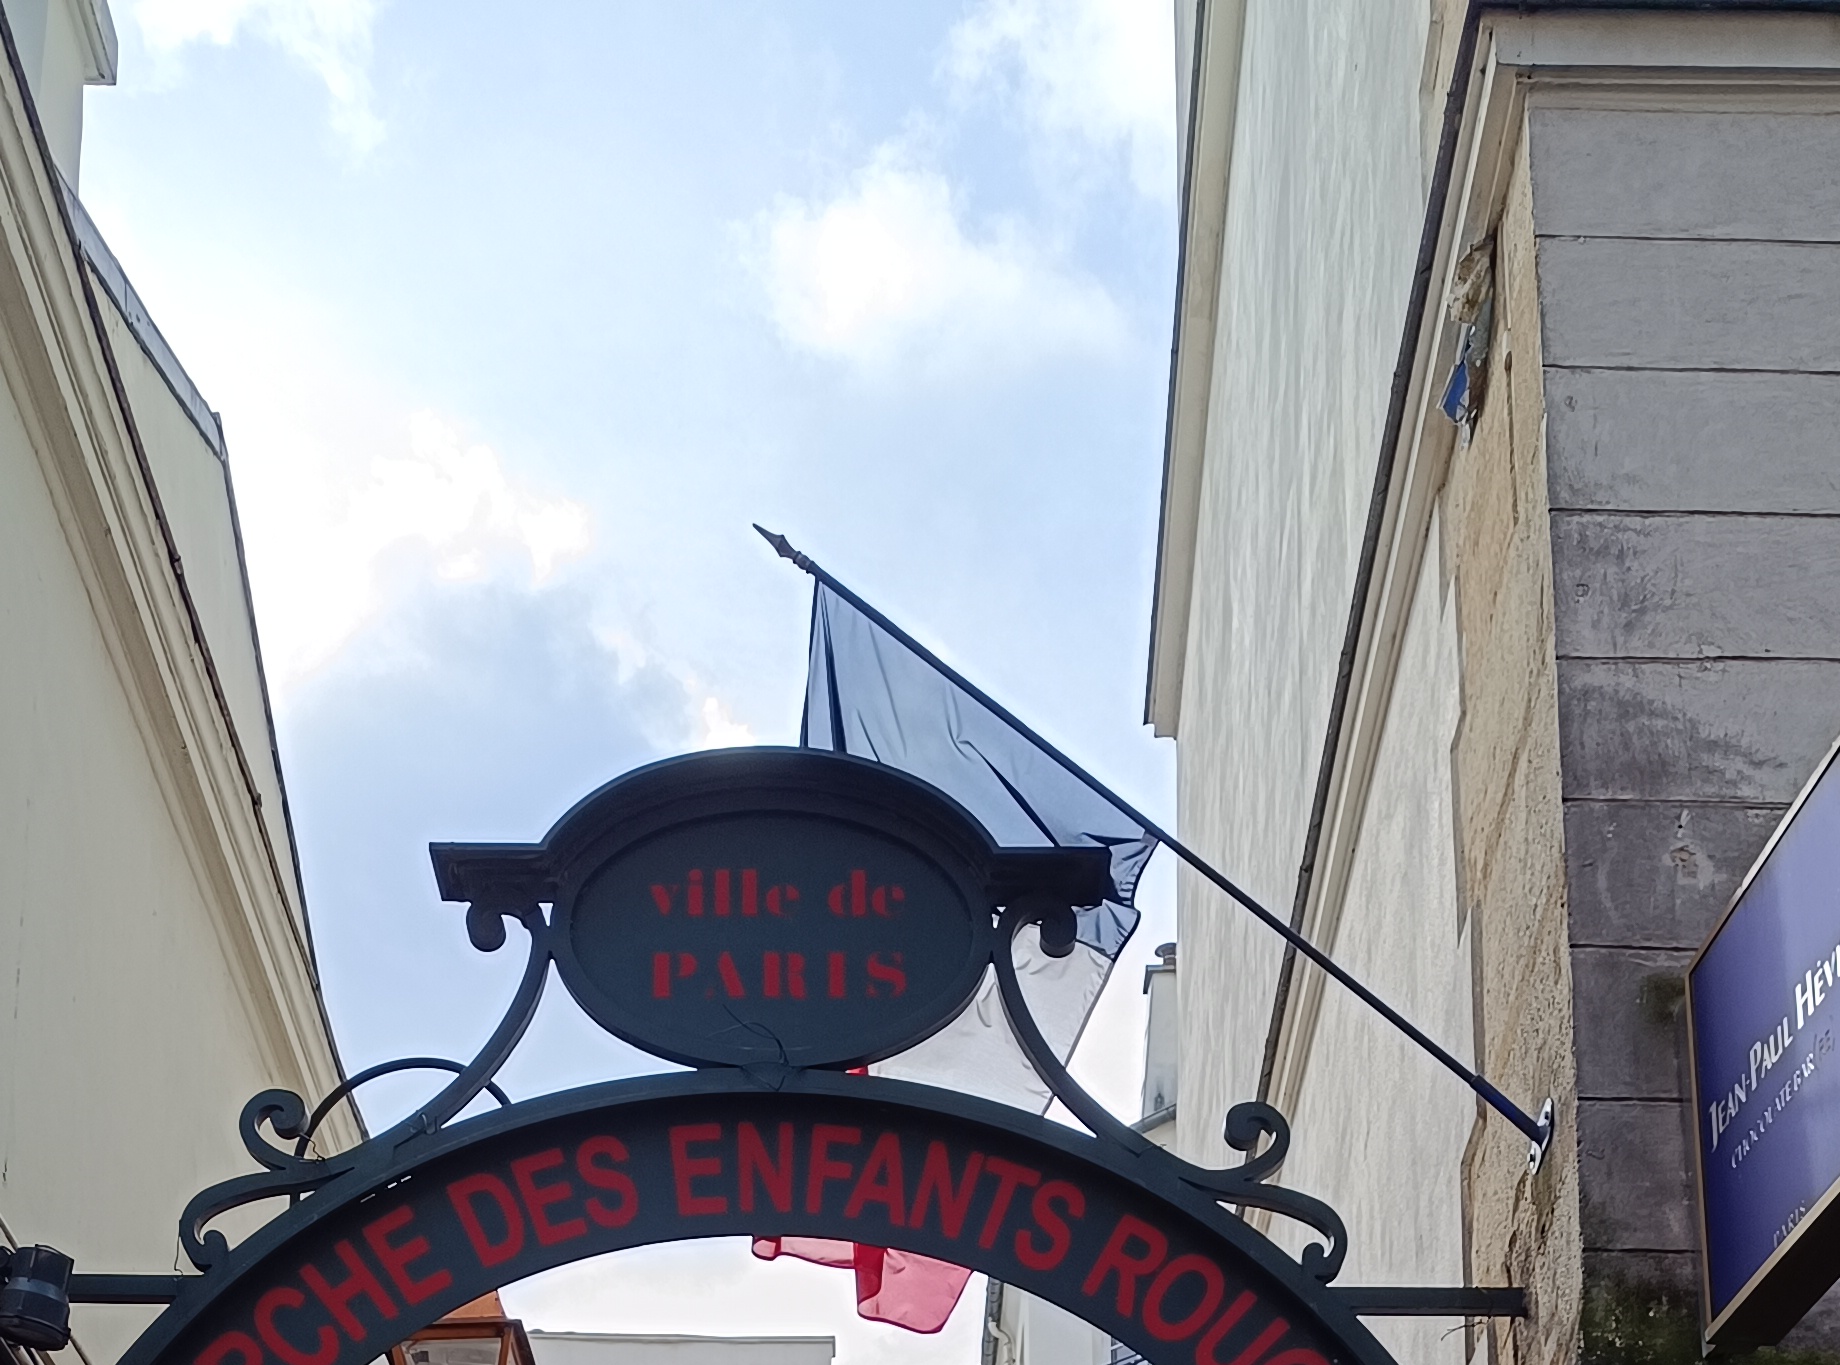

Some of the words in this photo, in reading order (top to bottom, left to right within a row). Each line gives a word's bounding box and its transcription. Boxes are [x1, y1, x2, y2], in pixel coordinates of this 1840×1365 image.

[651, 869, 800, 918] ville
[828, 870, 905, 918] de
[653, 951, 907, 999] PARIS
[1709, 1016, 1794, 1153] JEAN-PAUL
[447, 1136, 638, 1268] DES
[670, 1123, 1086, 1271] ENFANTS
